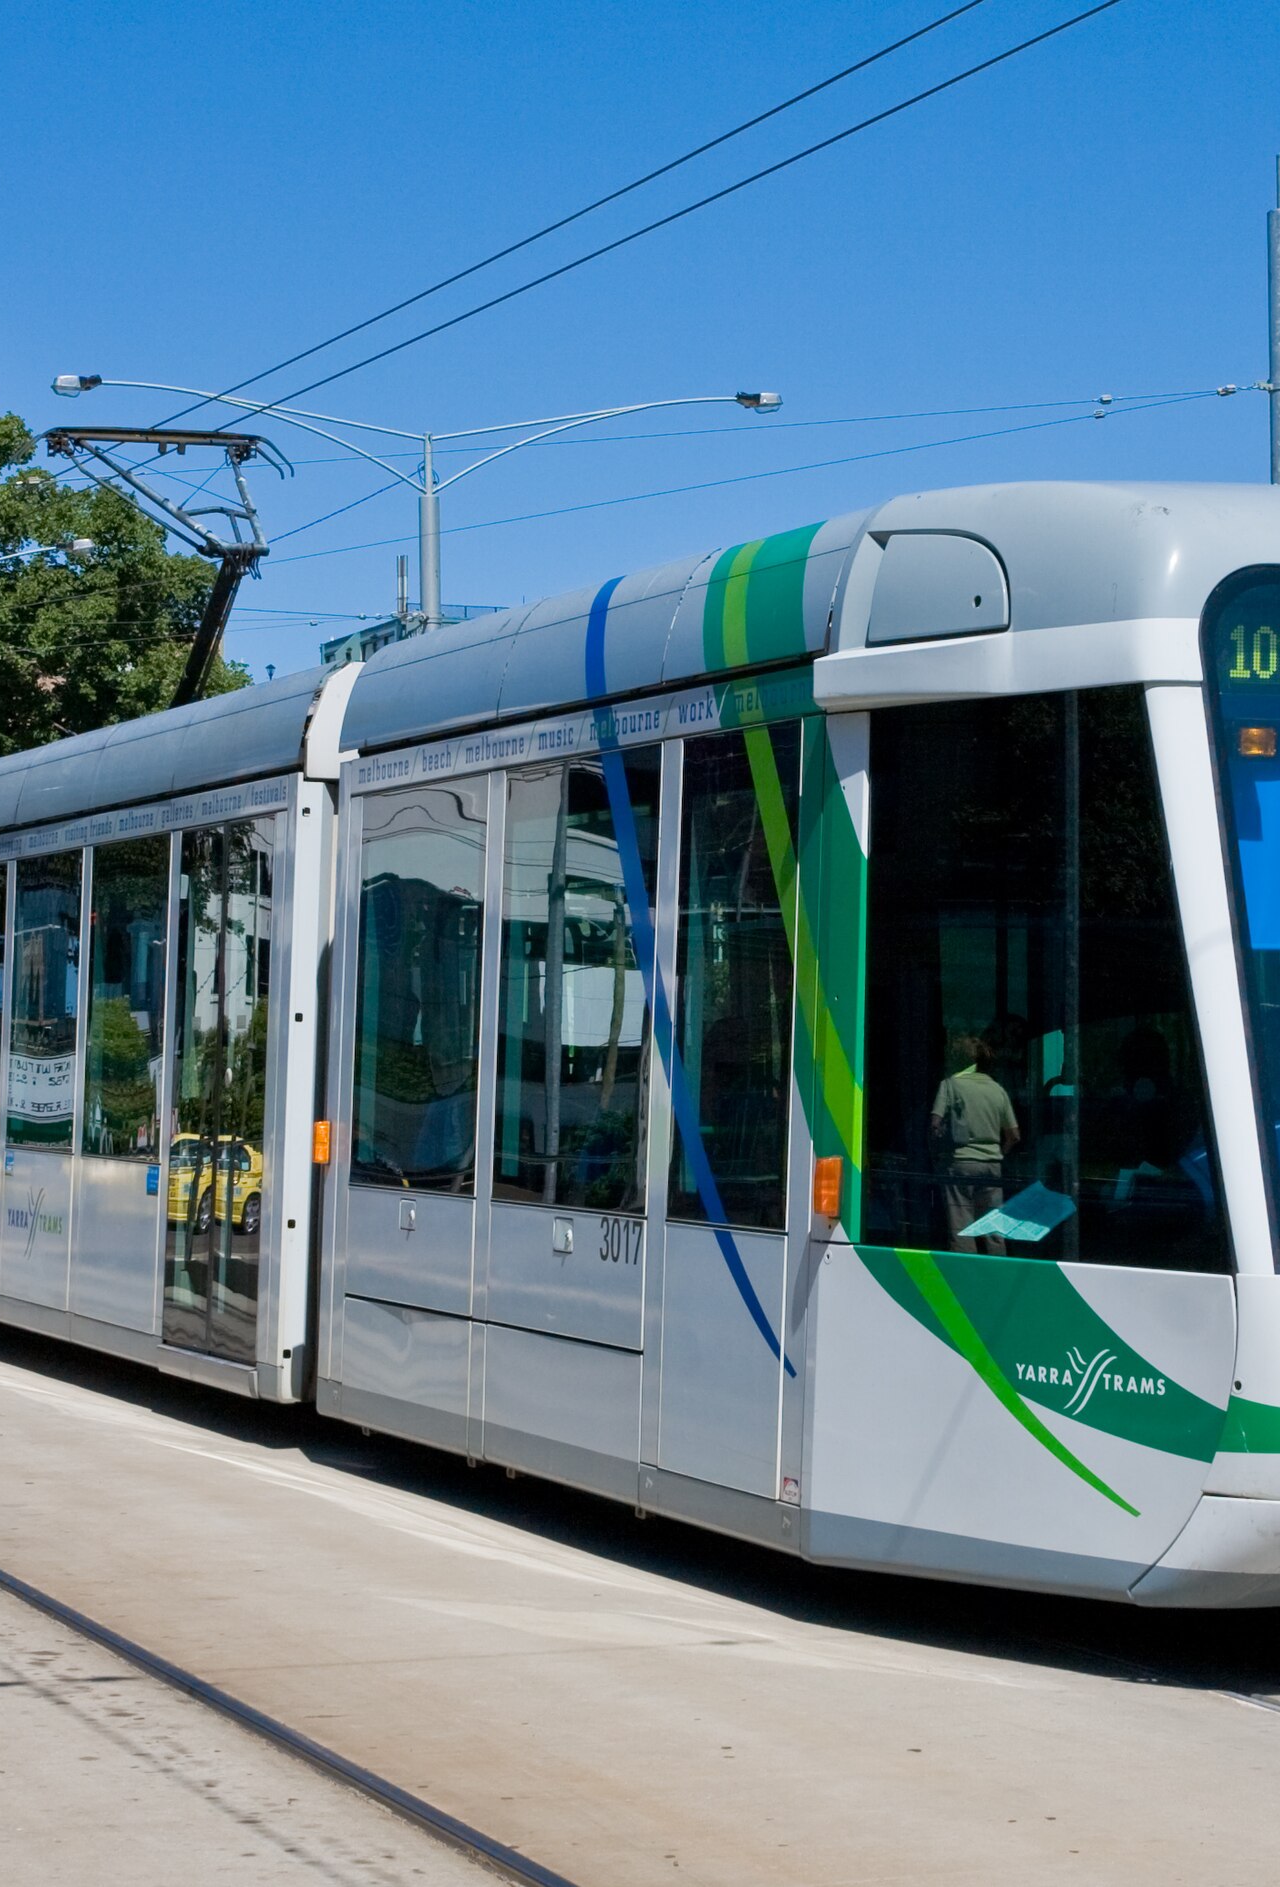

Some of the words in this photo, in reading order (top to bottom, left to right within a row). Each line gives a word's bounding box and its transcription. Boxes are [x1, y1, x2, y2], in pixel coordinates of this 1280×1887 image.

[358, 758, 409, 785] melbourne
[422, 745, 452, 773] beach
[465, 736, 525, 764] melbourne
[538, 723, 574, 751] music
[589, 708, 660, 742] melbourne
[678, 693, 714, 725] work
[89, 816, 113, 837] friends
[119, 811, 154, 832] melbourne
[161, 801, 193, 828] galleries
[201, 794, 242, 816] melbourne
[250, 780, 287, 806] festivals
[7, 1208, 29, 1229] YARRA
[39, 1213, 62, 1235] TRAMS
[599, 1216, 643, 1265] 3017
[1015, 1363, 1074, 1387] YARRA
[1102, 1373, 1166, 1396] TRAMS
